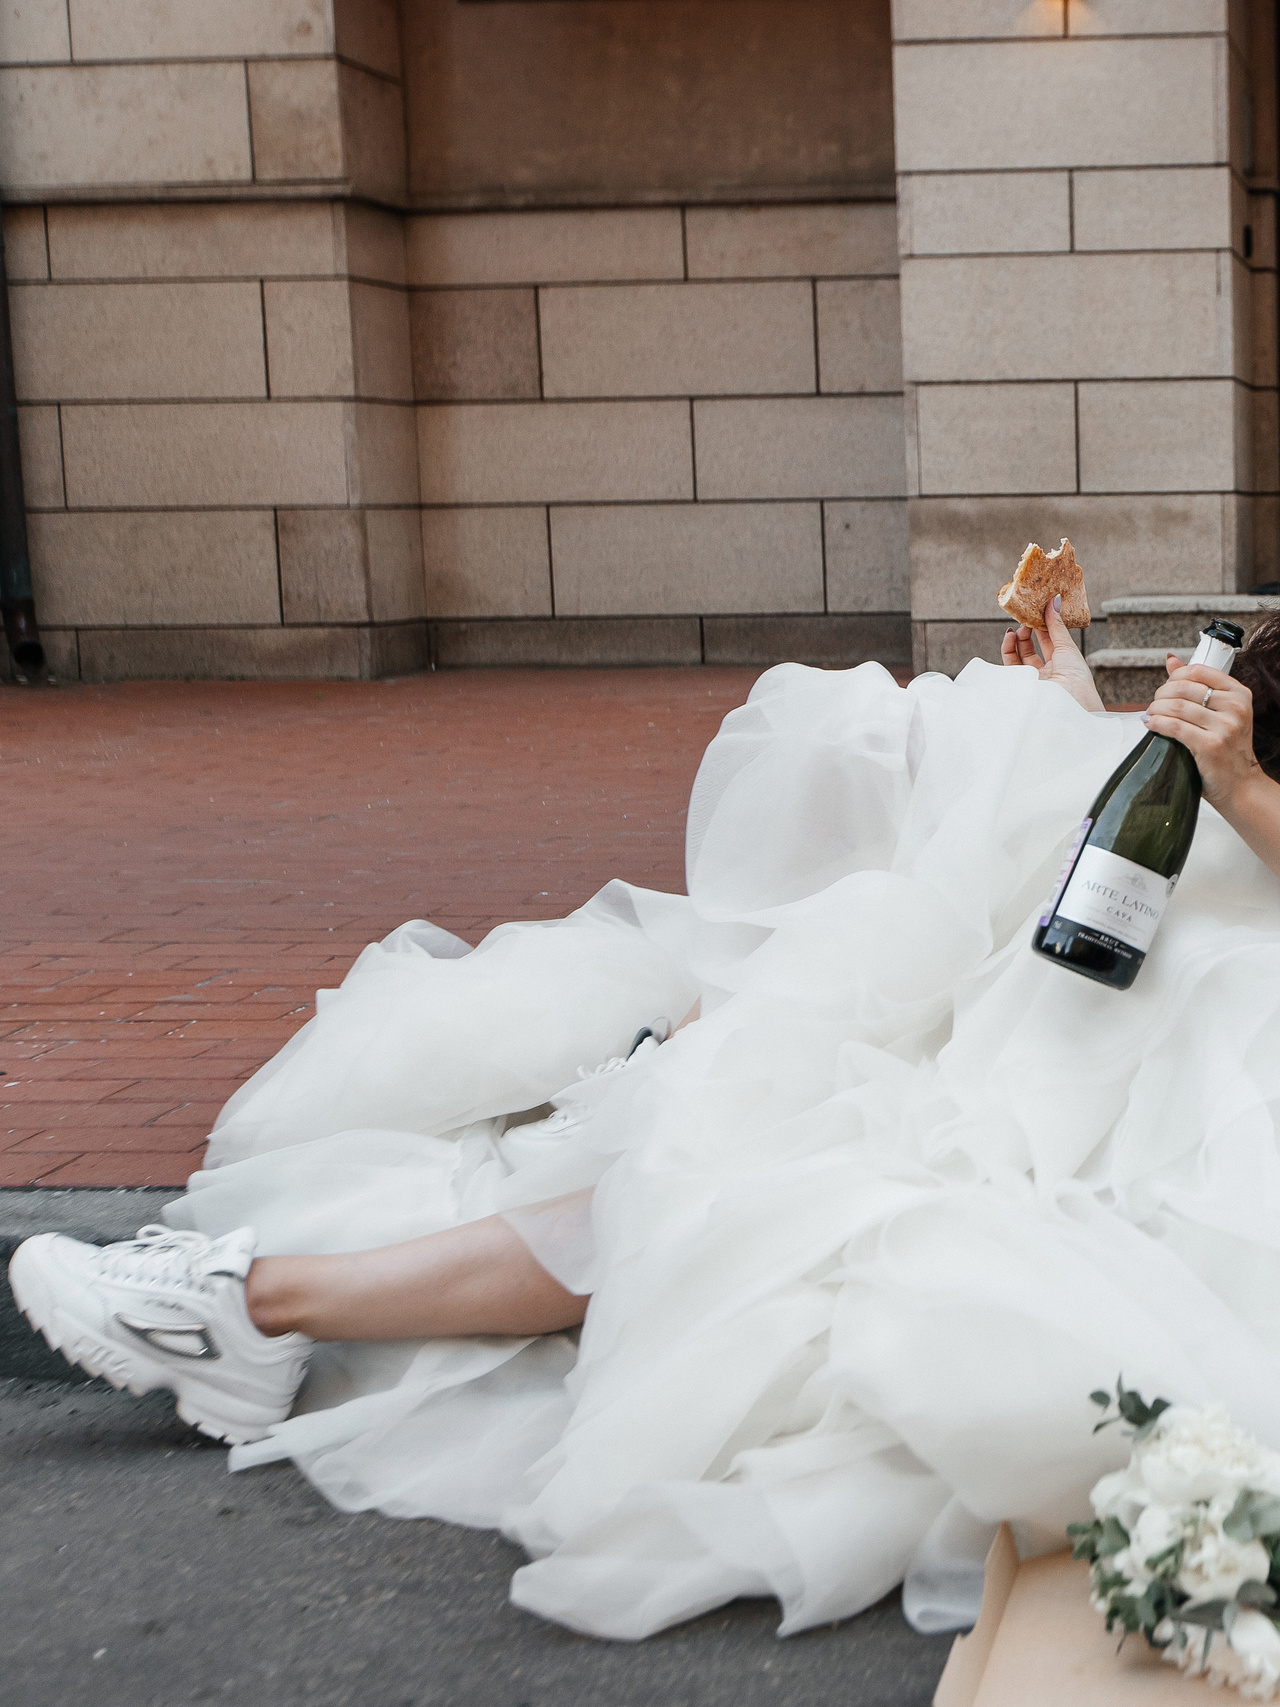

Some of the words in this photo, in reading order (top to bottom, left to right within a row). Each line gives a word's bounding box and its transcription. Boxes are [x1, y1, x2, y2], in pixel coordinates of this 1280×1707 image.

[1081, 880, 1118, 901] ARTE
[1121, 895, 1159, 920] LATINO
[1106, 905, 1132, 922] CAVA
[1099, 934, 1119, 947] BRUT
